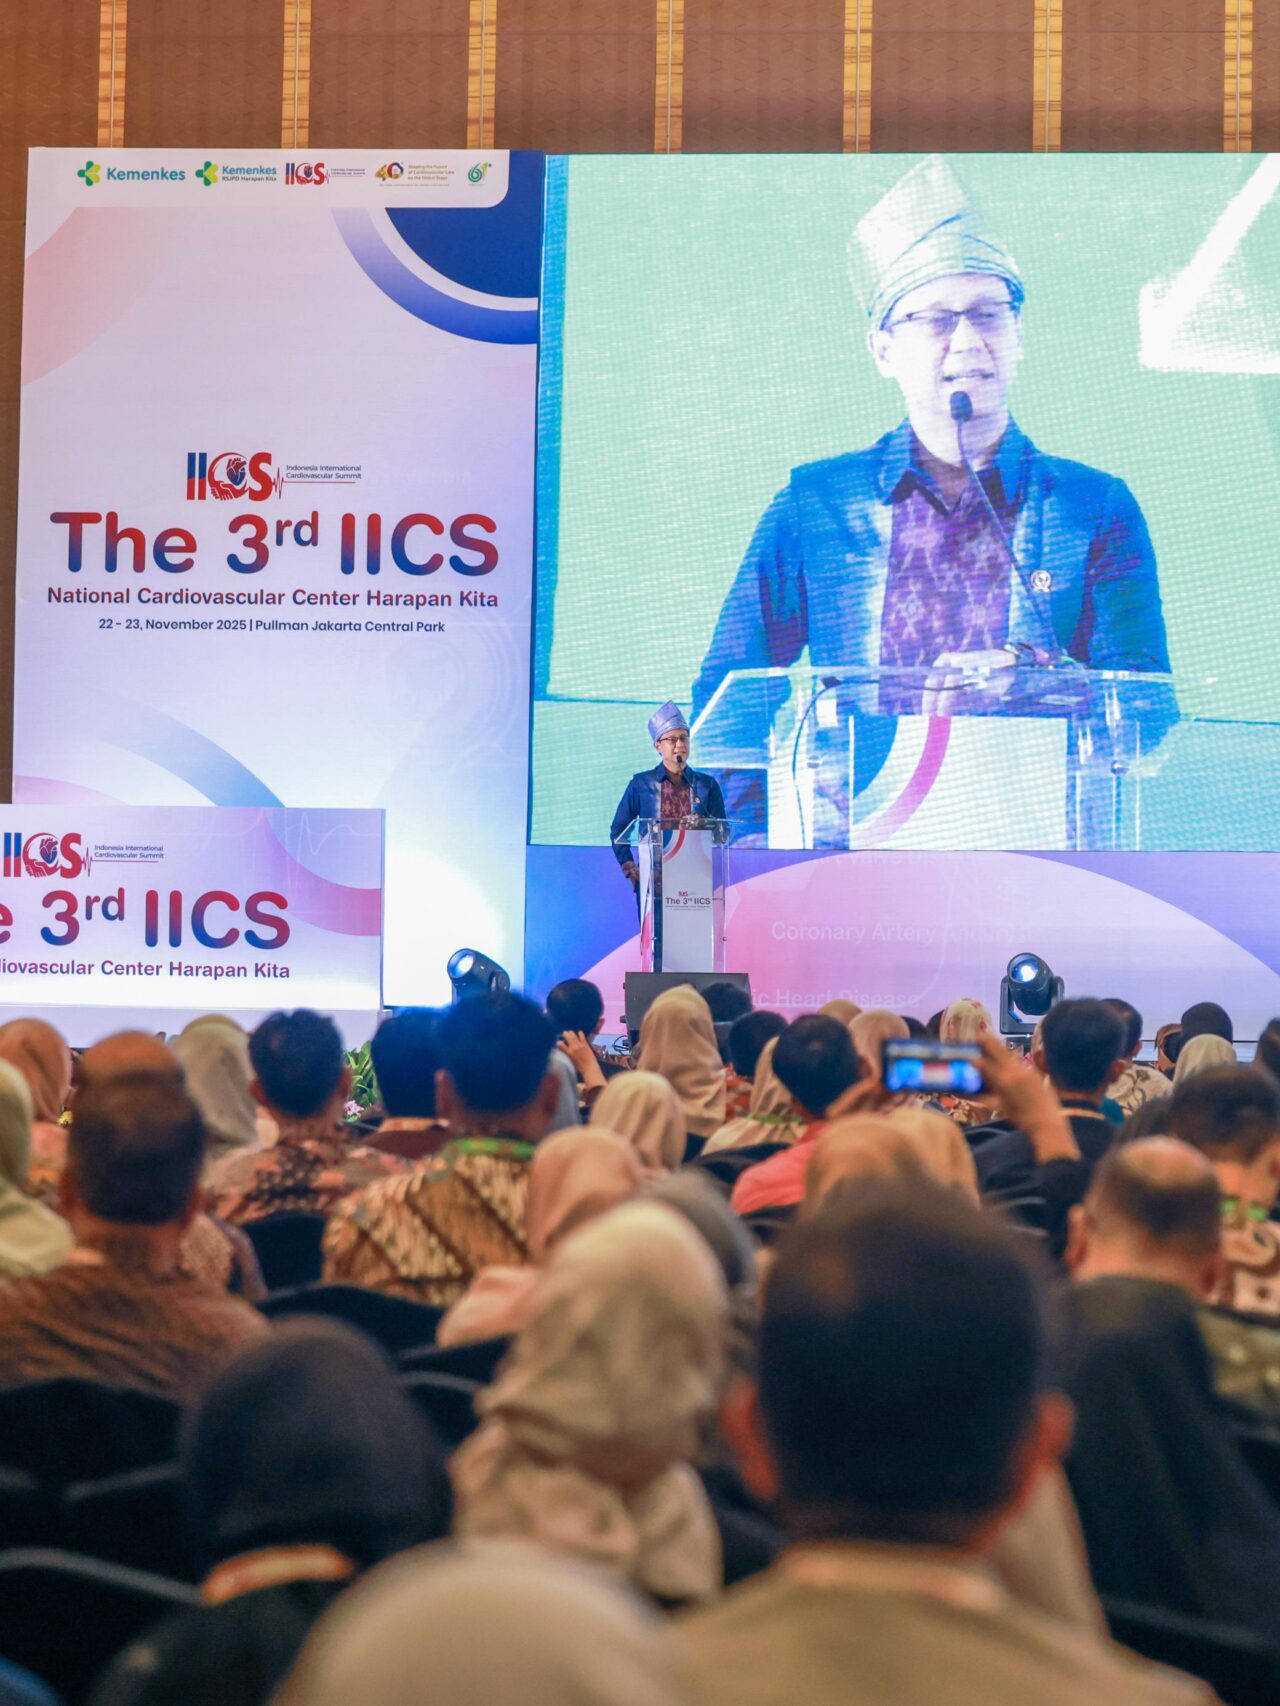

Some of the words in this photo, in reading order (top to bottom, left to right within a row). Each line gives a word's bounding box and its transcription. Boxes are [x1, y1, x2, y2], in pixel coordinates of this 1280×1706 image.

[107, 167, 185, 181] Kemenkes
[222, 165, 277, 175] Kemenkes
[50, 511, 198, 574] The
[227, 510, 319, 574] 3rd
[341, 513, 499, 577] IICS
[48, 587, 130, 604] National
[137, 588, 286, 605] Cardiovascular
[292, 589, 360, 606] Center
[367, 590, 452, 610] Harapan
[460, 591, 499, 607] Kita
[99, 619, 114, 629] 22
[125, 619, 143, 632] 23,
[146, 619, 214, 630] November
[216, 620, 247, 630] 2025
[256, 620, 309, 631] Pullman
[311, 620, 362, 631] Jakarta
[364, 621, 414, 632] Central
[416, 621, 445, 632] Park
[94, 851, 138, 859] Cardiovascular
[125, 844, 164, 852] International
[665, 897, 681, 905] The
[40, 887, 125, 947] 3rd
[145, 890, 291, 950] IICS
[771, 921, 865, 943] Coronary
[871, 921, 936, 944] Artery
[0, 958, 95, 975] iovascular
[101, 960, 163, 977] Center
[169, 961, 248, 981] Harapan
[254, 962, 291, 979] Kita
[776, 988, 833, 1008] Heart
